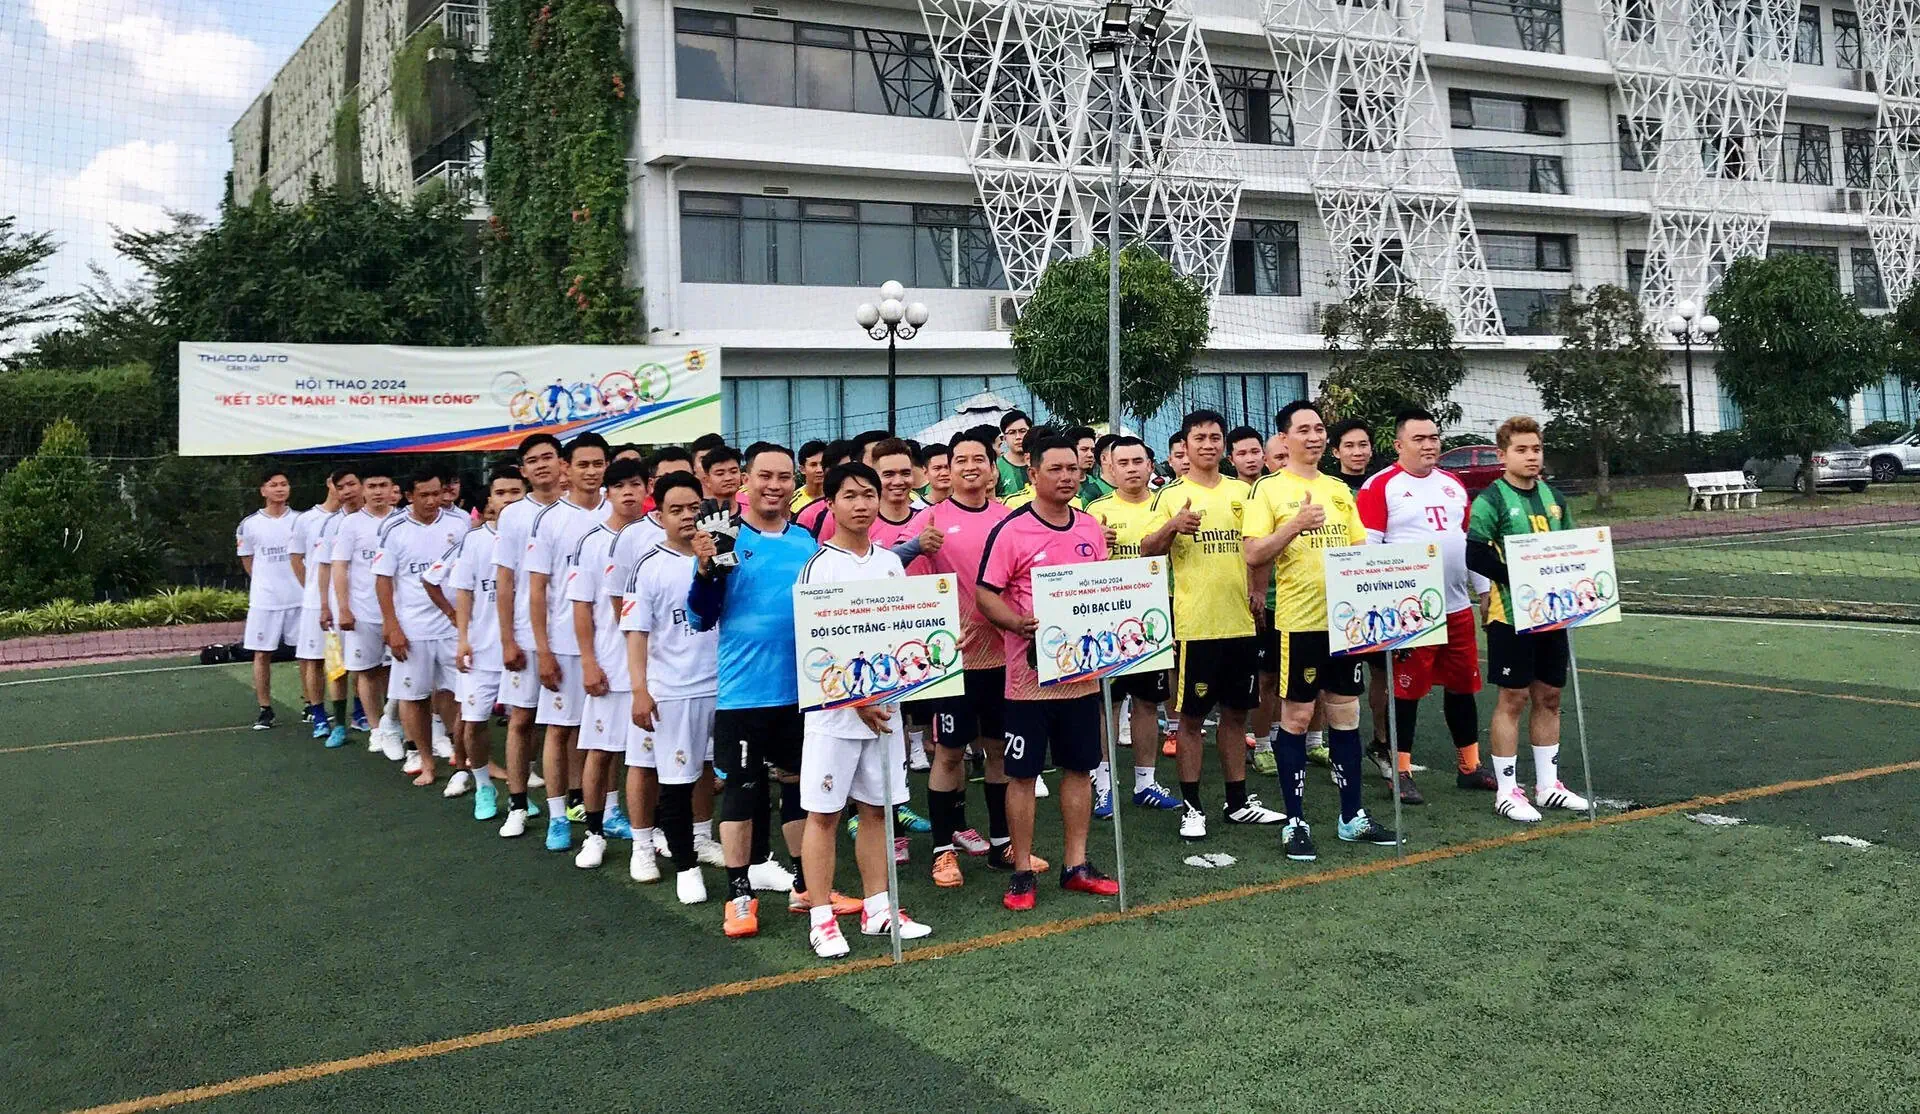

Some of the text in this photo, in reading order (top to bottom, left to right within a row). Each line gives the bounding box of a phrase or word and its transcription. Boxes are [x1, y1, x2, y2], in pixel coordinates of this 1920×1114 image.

[198, 353, 288, 363] THACO AUTO
[295, 376, 407, 392] HỘI THAO 2024
[256, 391, 288, 406] SỨC
[291, 394, 336, 407] MẠNH
[349, 391, 375, 405] NỐI
[379, 392, 429, 405] THÀNH
[1203, 543, 1216, 554] FLY
[1310, 537, 1323, 549] FLY
[1079, 579, 1090, 587] HỘI
[1356, 579, 1416, 595] ĐỘI VĨNH LONG
[850, 598, 864, 606] HỘI
[1072, 598, 1132, 617] ĐỘI BẠC LIÊU
[810, 626, 829, 640] ĐỘI
[831, 624, 851, 636] SÓC
[893, 618, 913, 632] HẬU
[915, 617, 946, 628] GIANG
[1354, 662, 1362, 684] 6
[940, 713, 954, 734] 19
[1004, 731, 1025, 760] 79
[739, 740, 748, 768] 1
